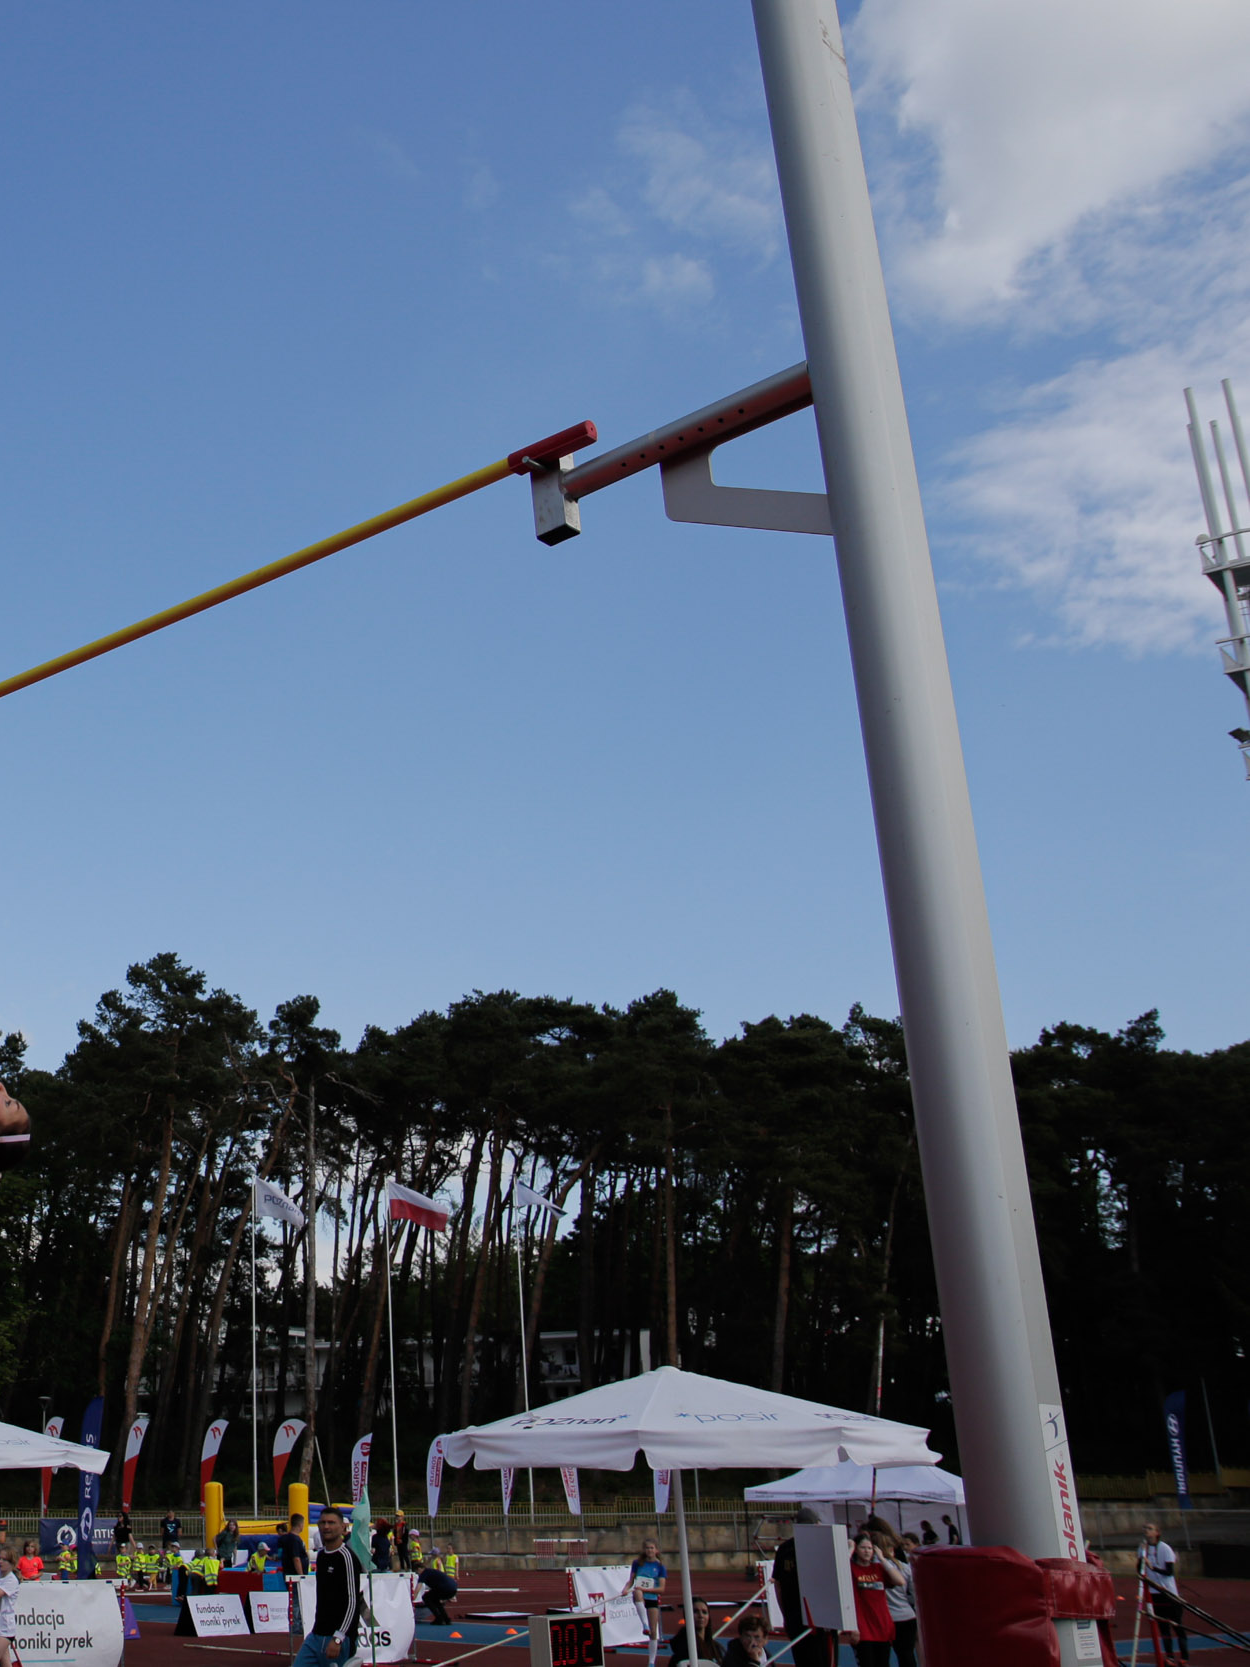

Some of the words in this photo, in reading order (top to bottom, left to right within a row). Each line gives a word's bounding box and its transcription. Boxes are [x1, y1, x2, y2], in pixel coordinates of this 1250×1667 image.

[1170, 1438, 1187, 1495] HYUNDAI
[1054, 1459, 1079, 1562] olanik
[15, 1607, 65, 1630] ndacja
[196, 1603, 225, 1615] fundacja
[200, 1616, 221, 1627] moniki
[222, 1614, 241, 1628] pyrek
[56, 1630, 94, 1655] pyrek
